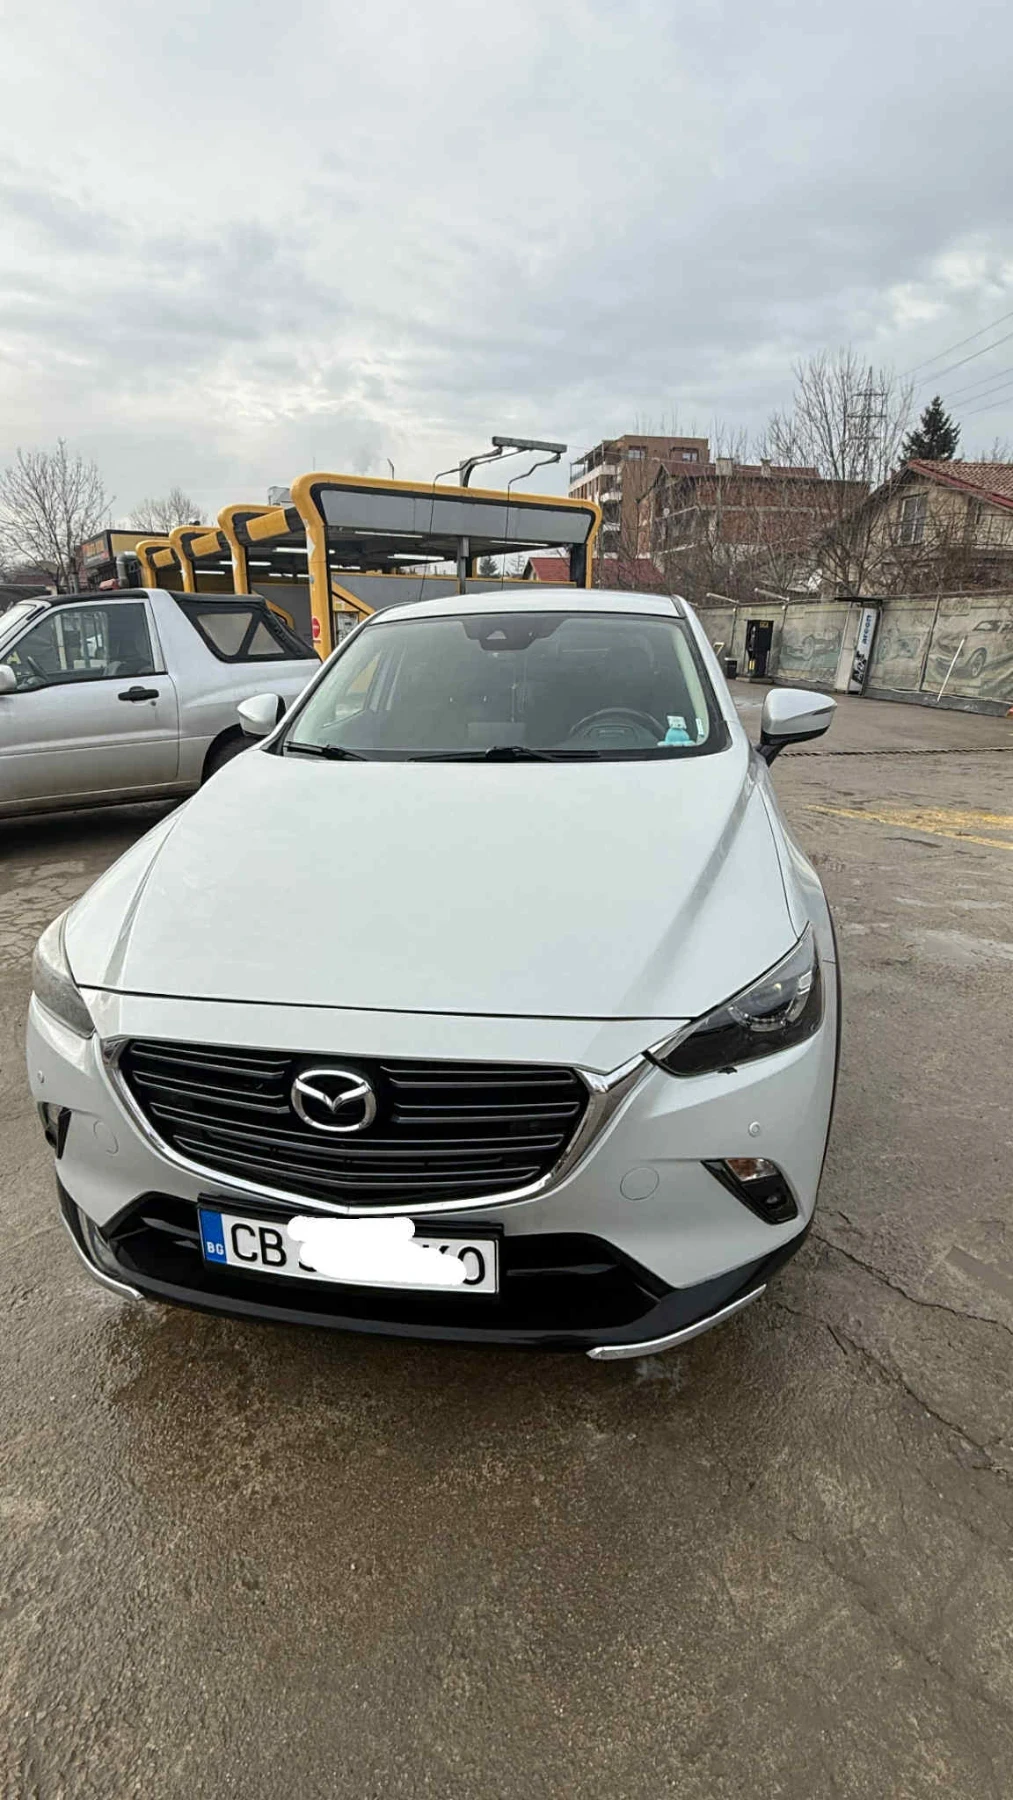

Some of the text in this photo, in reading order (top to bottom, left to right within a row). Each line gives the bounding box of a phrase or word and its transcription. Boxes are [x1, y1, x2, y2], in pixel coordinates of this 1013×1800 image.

[862, 614, 872, 645] areon
[206, 1241, 224, 1255] BG
[230, 1223, 486, 1286] CB O
